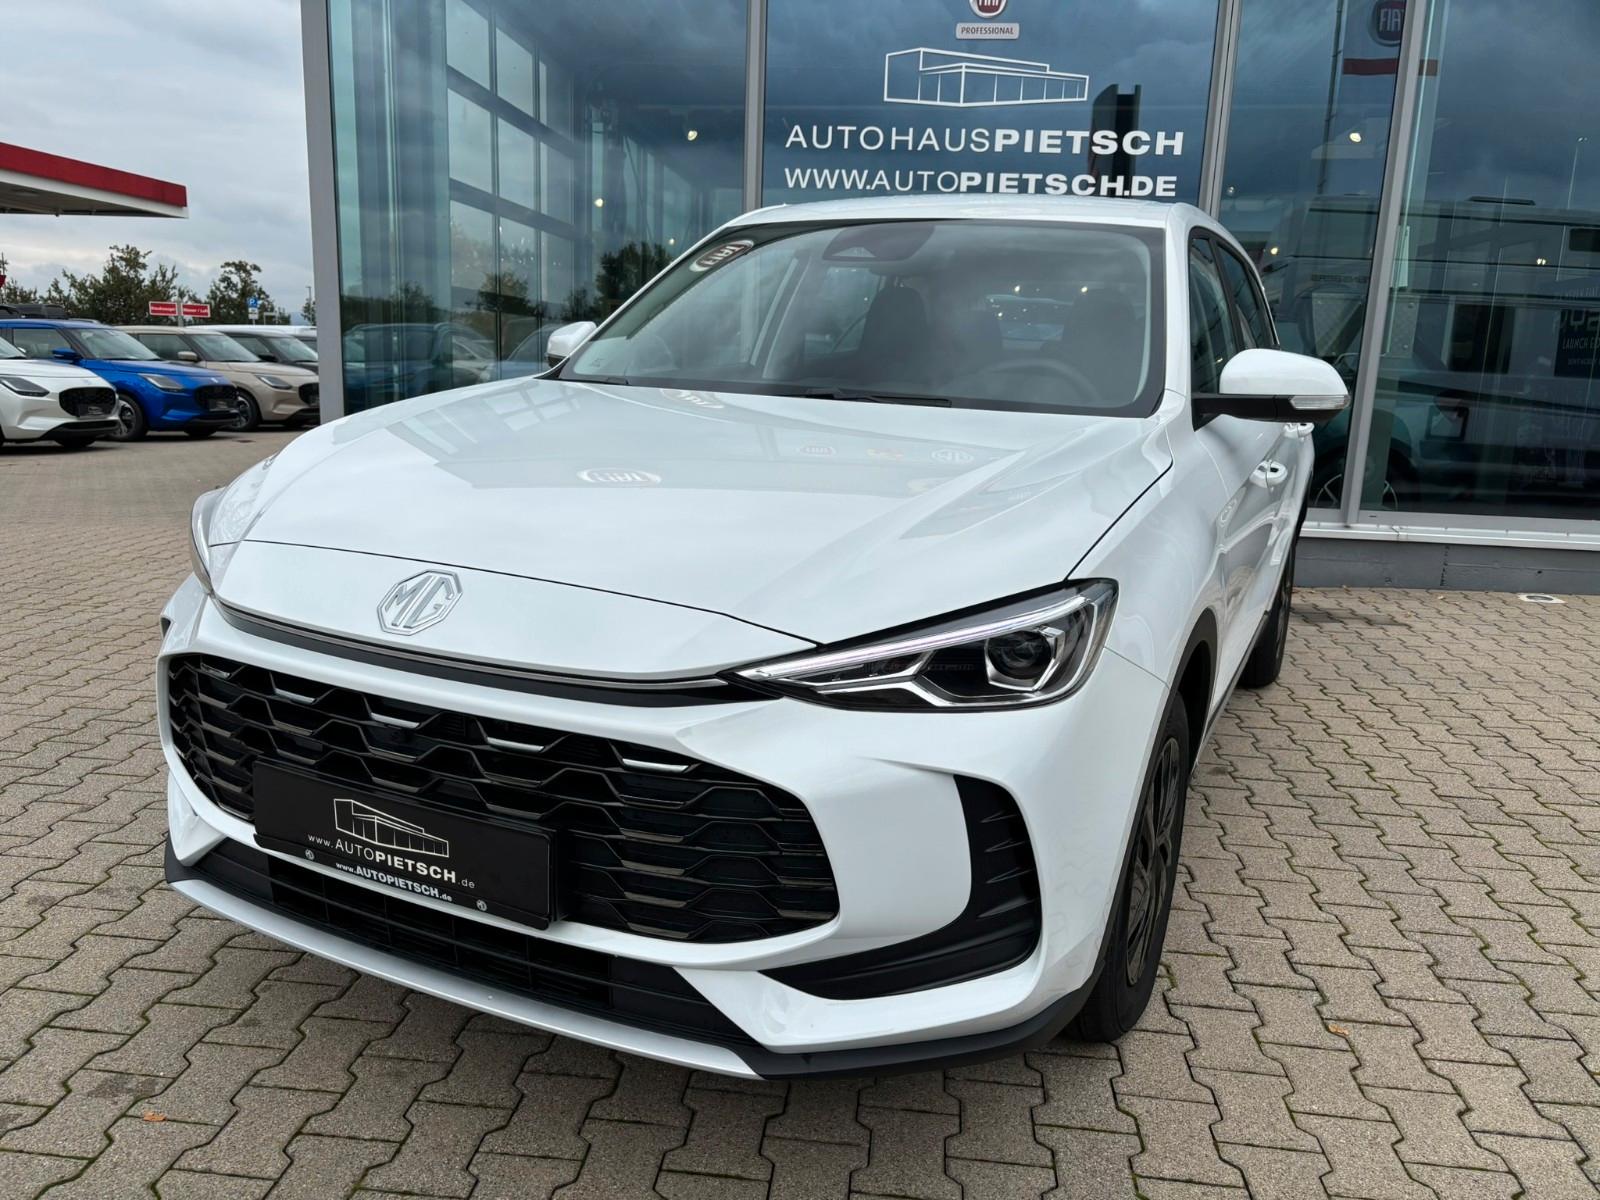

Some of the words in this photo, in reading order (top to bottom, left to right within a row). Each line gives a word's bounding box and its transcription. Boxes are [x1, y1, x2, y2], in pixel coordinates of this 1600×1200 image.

[960, 26, 1014, 35] PROFESSIONAL
[785, 124, 1184, 156] AUTOHAUSPIETSCH
[784, 167, 1178, 197] WWW.AUTOPIETSCH.DE
[384, 575, 454, 628] MG
[335, 862, 453, 902] www.AUTOPIETSCH.de
